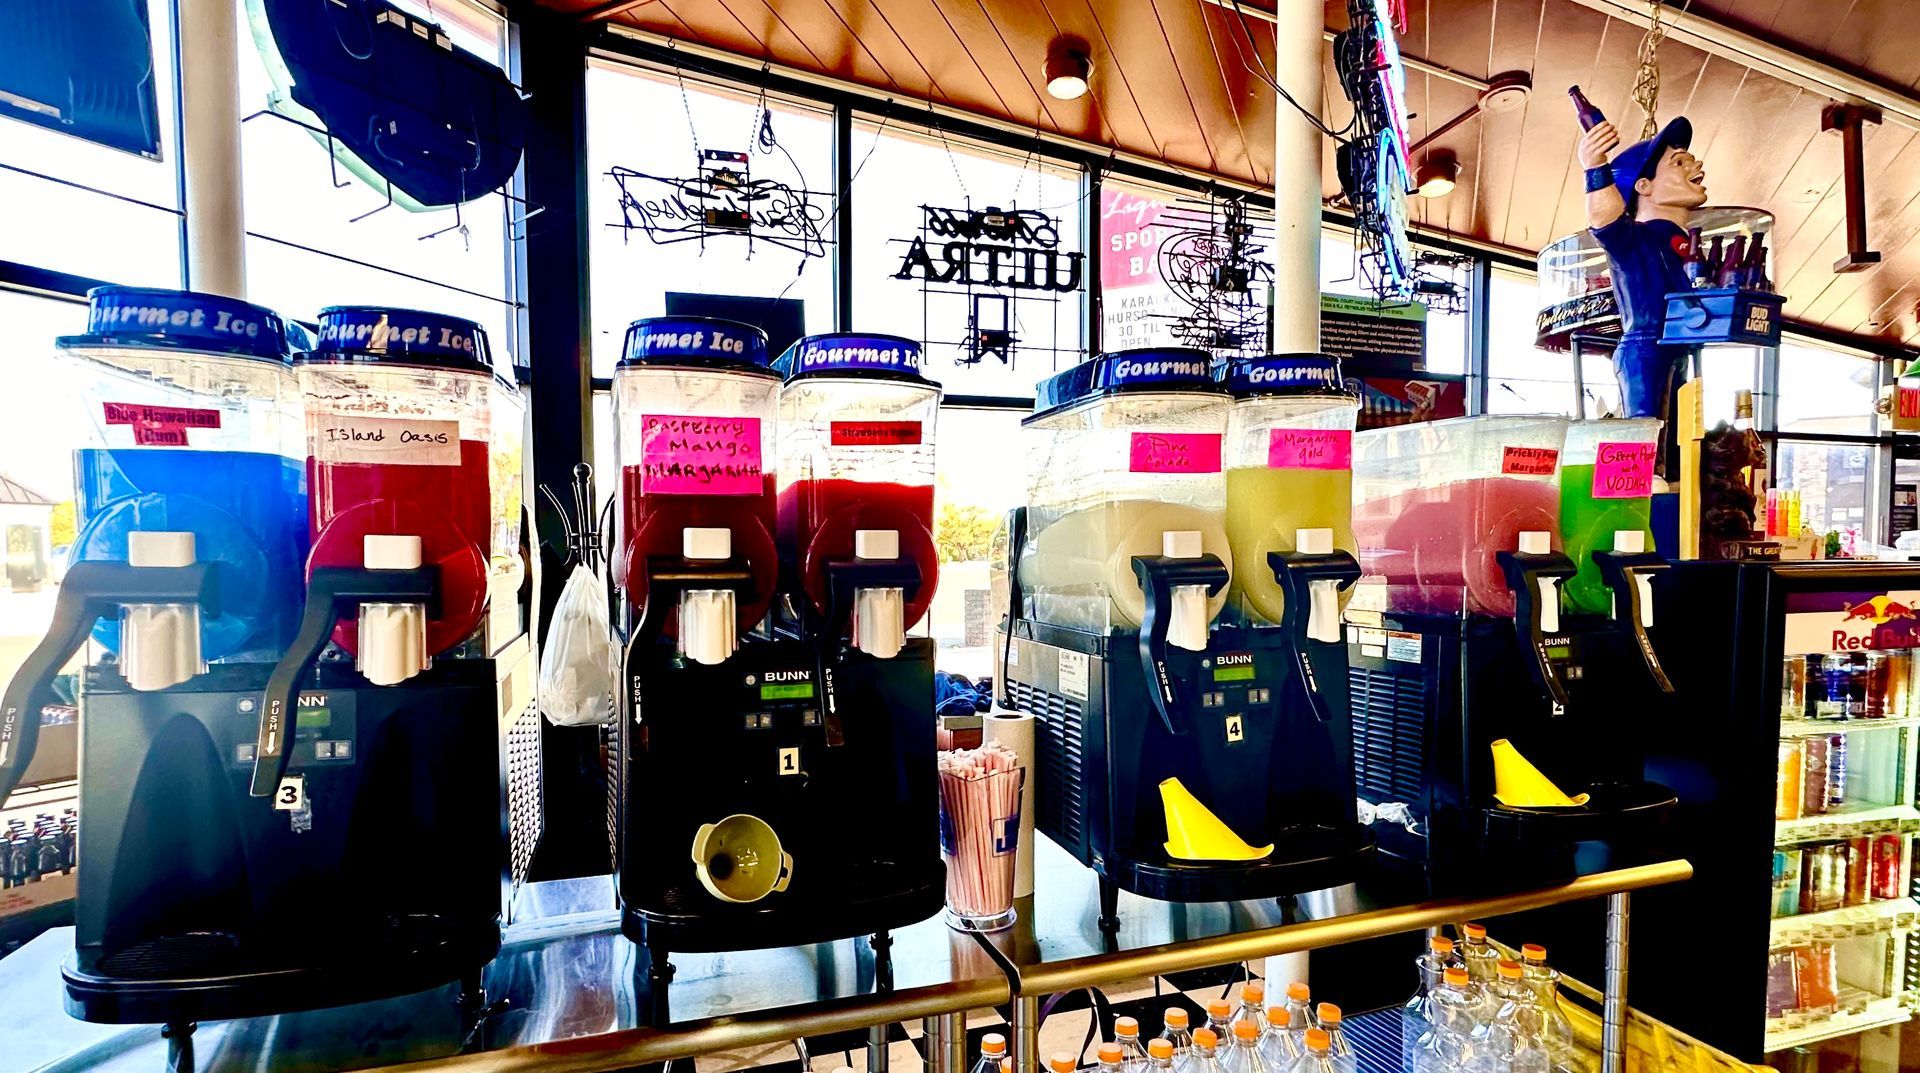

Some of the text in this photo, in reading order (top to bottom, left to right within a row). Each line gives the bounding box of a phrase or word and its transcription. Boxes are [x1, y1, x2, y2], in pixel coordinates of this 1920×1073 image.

[1103, 191, 1166, 224] Liqu
[1751, 306, 1768, 318] BUD
[213, 310, 259, 337] Ice
[1745, 319, 1769, 333] LIGHT
[438, 328, 474, 352] Ice
[709, 331, 744, 354] Ice
[804, 346, 922, 370] Gourmet Ic
[1115, 359, 1205, 378] Gourmet
[1248, 364, 1335, 384] Gourmet
[143, 408, 217, 426] Hawaiian
[1506, 448, 1541, 460] Prickly
[1545, 637, 1570, 646] BUNN
[1832, 628, 1876, 651] Red
[1216, 655, 1252, 665] BUNN
[1301, 652, 1313, 677] PUSH
[765, 671, 809, 681] BUNN
[825, 668, 834, 693] PUSH
[1157, 661, 1169, 685] PUSH
[633, 675, 642, 702] PUSH
[297, 695, 326, 707] NN
[1, 707, 17, 741] PUSH
[269, 700, 281, 731] PUSH
[1229, 721, 1241, 737] 4
[783, 753, 795, 771] 1
[279, 785, 298, 804] 3
